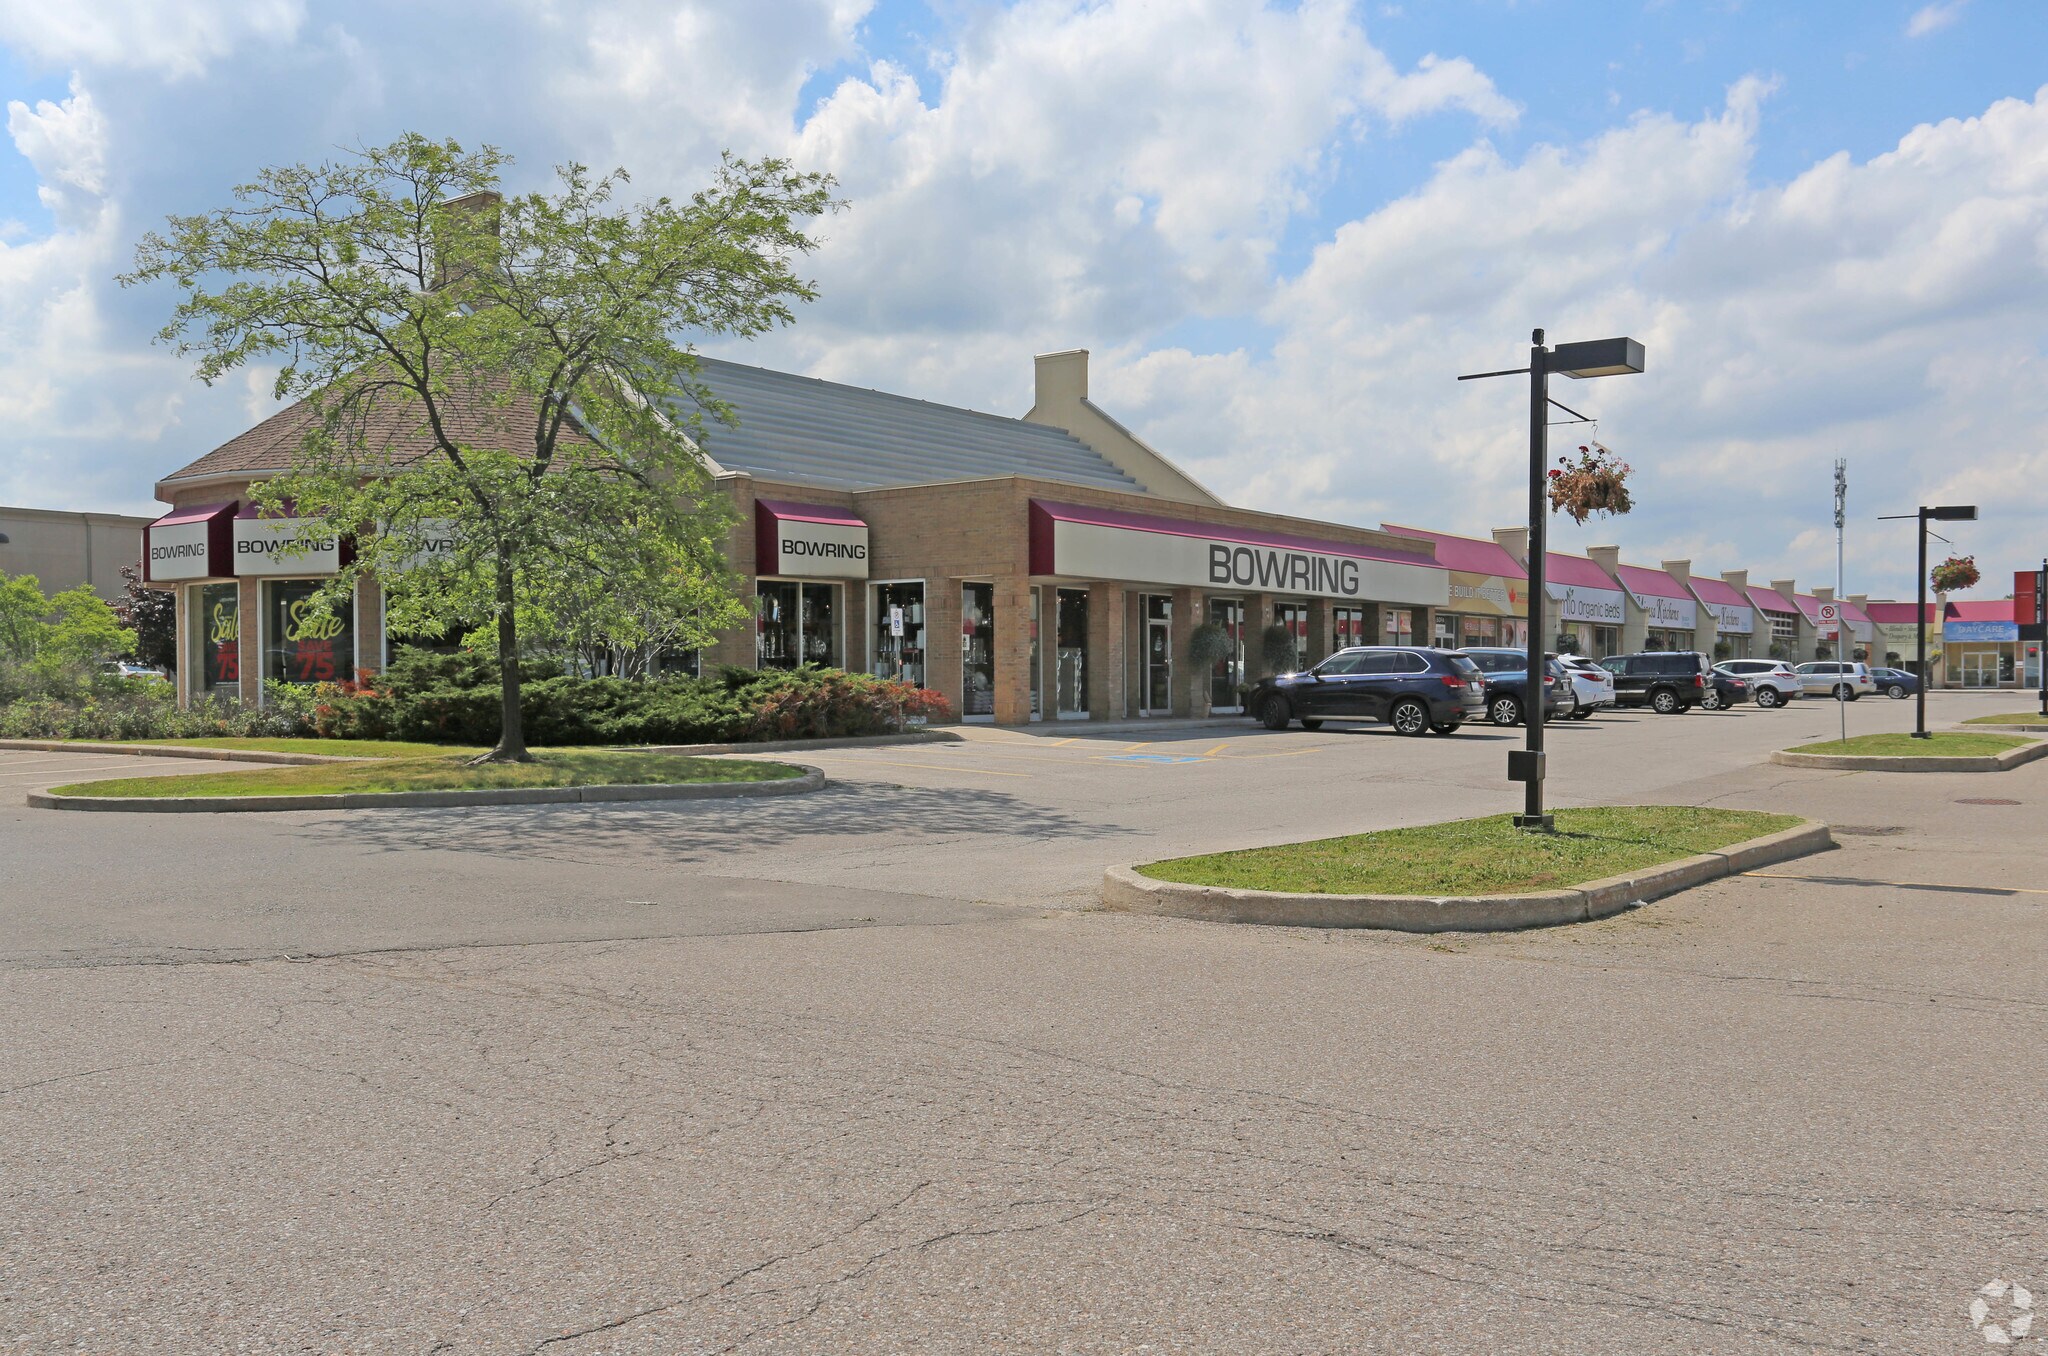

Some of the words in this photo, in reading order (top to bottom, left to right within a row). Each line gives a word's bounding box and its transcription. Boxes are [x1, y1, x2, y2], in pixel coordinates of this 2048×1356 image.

[151, 543, 205, 560] BOWRING
[782, 539, 866, 559] BOWRING
[1209, 544, 1359, 595] BOWRING
[1454, 585, 1474, 598] BUILD
[1578, 601, 1603, 618] Organic
[1605, 603, 1620, 618] Beds
[286, 600, 345, 641] Sle
[1959, 625, 2005, 634] DAYCARE
[298, 640, 332, 651] SAVE
[217, 653, 239, 680] 75
[297, 652, 335, 680] 75
